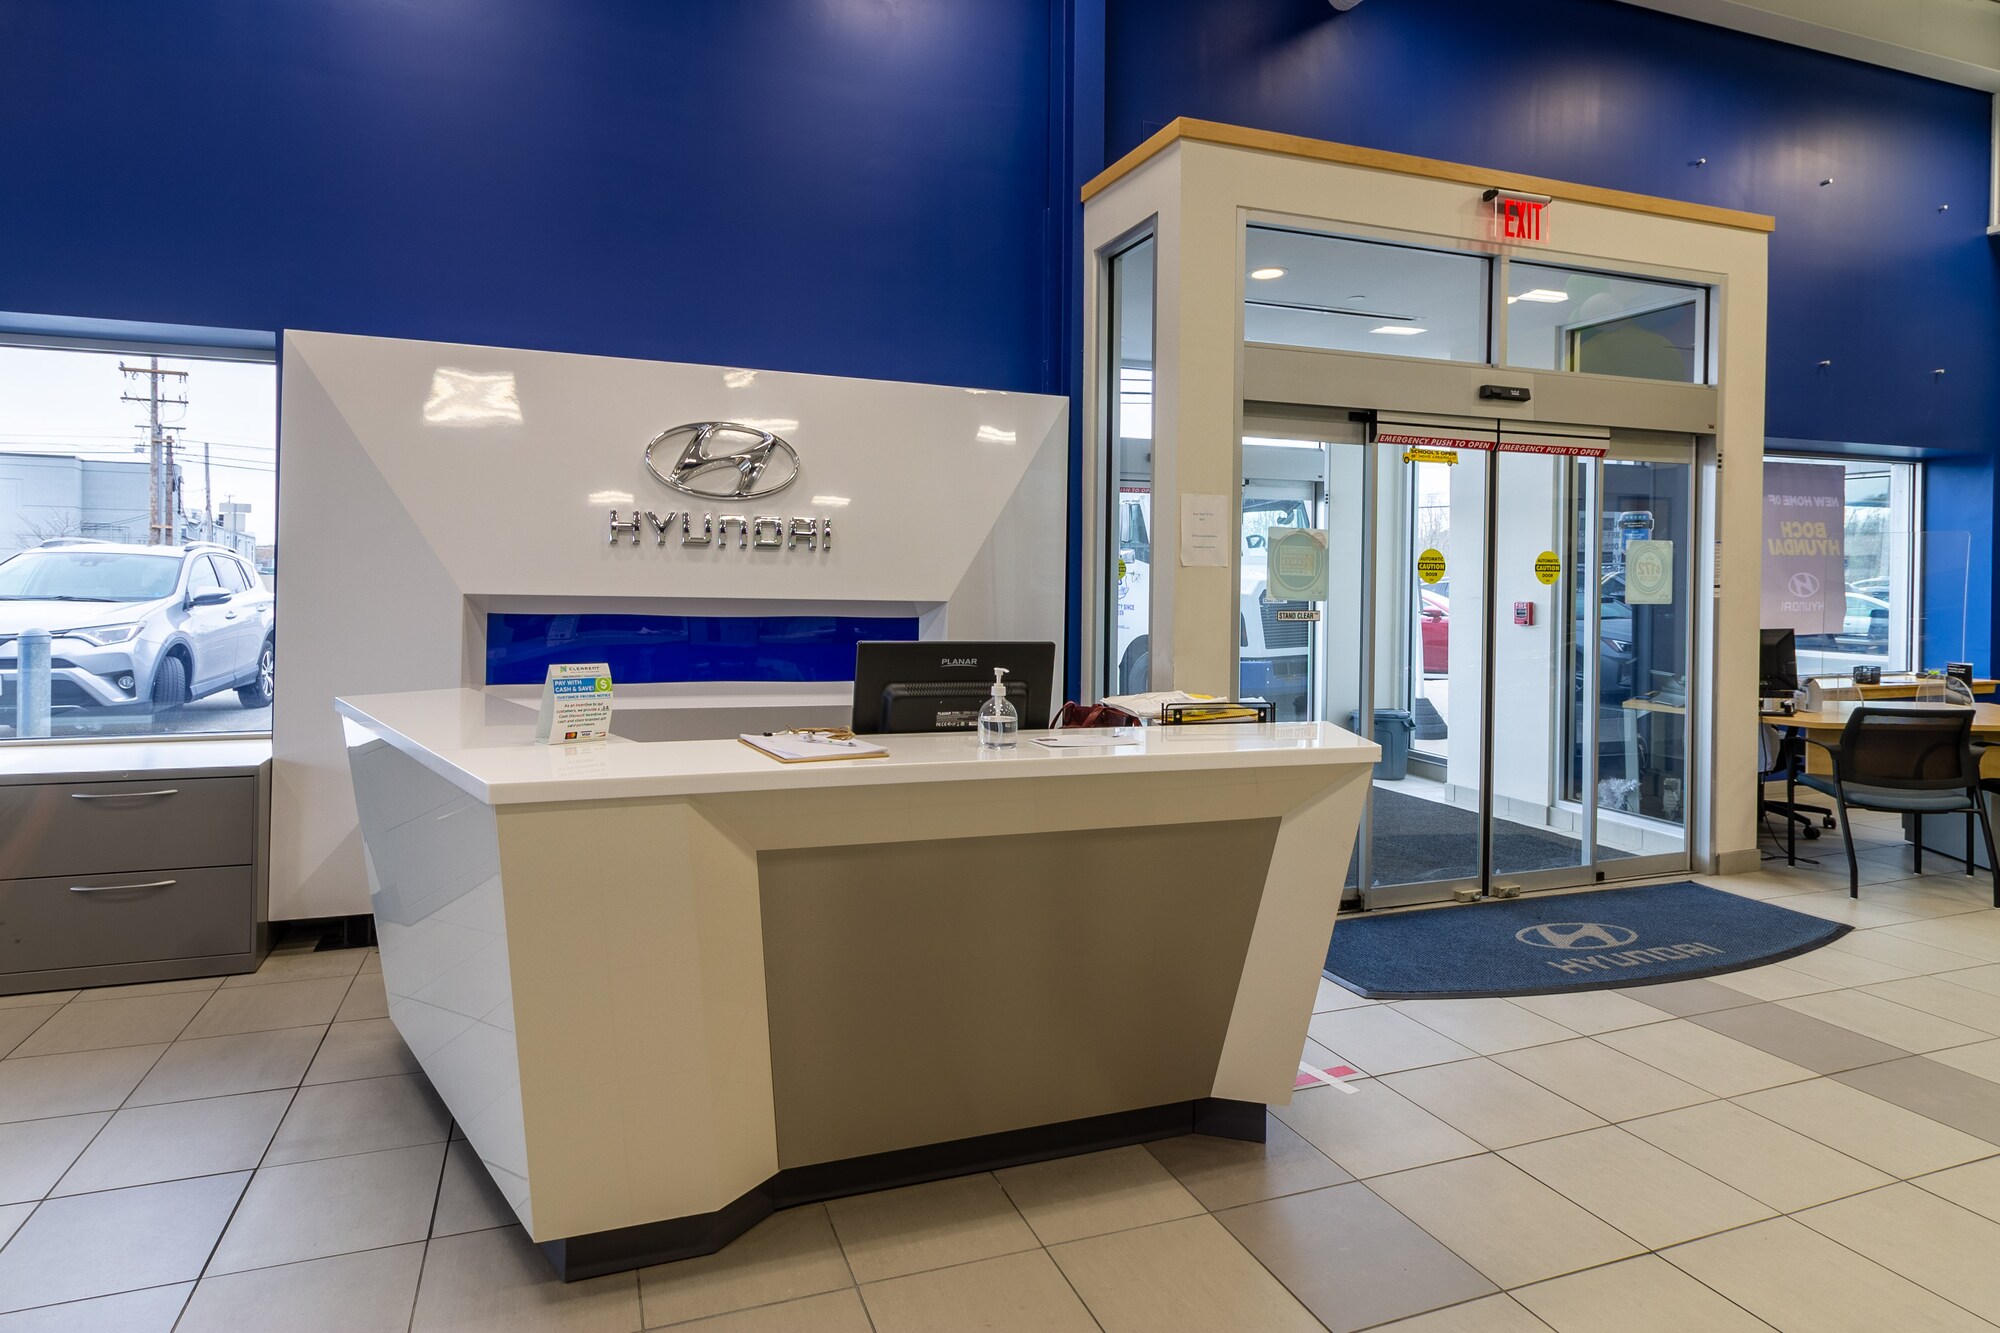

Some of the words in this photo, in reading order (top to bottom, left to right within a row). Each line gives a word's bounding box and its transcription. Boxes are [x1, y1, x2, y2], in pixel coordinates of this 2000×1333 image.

[1504, 198, 1543, 240] EXIT
[1379, 434, 1430, 445] EMERGENCY
[1431, 437, 1453, 447] PUSH
[1455, 440, 1465, 448] TO
[1467, 441, 1490, 449] OPEN
[1499, 443, 1545, 452] EMERGENCY
[1545, 446, 1567, 454] PUSH
[1580, 448, 1601, 456] OPEN
[609, 510, 832, 550] HYUNDAI
[1278, 612, 1296, 620] STAND
[1297, 612, 1314, 620] CLEAR
[1547, 941, 1727, 974] HYUNDAI
